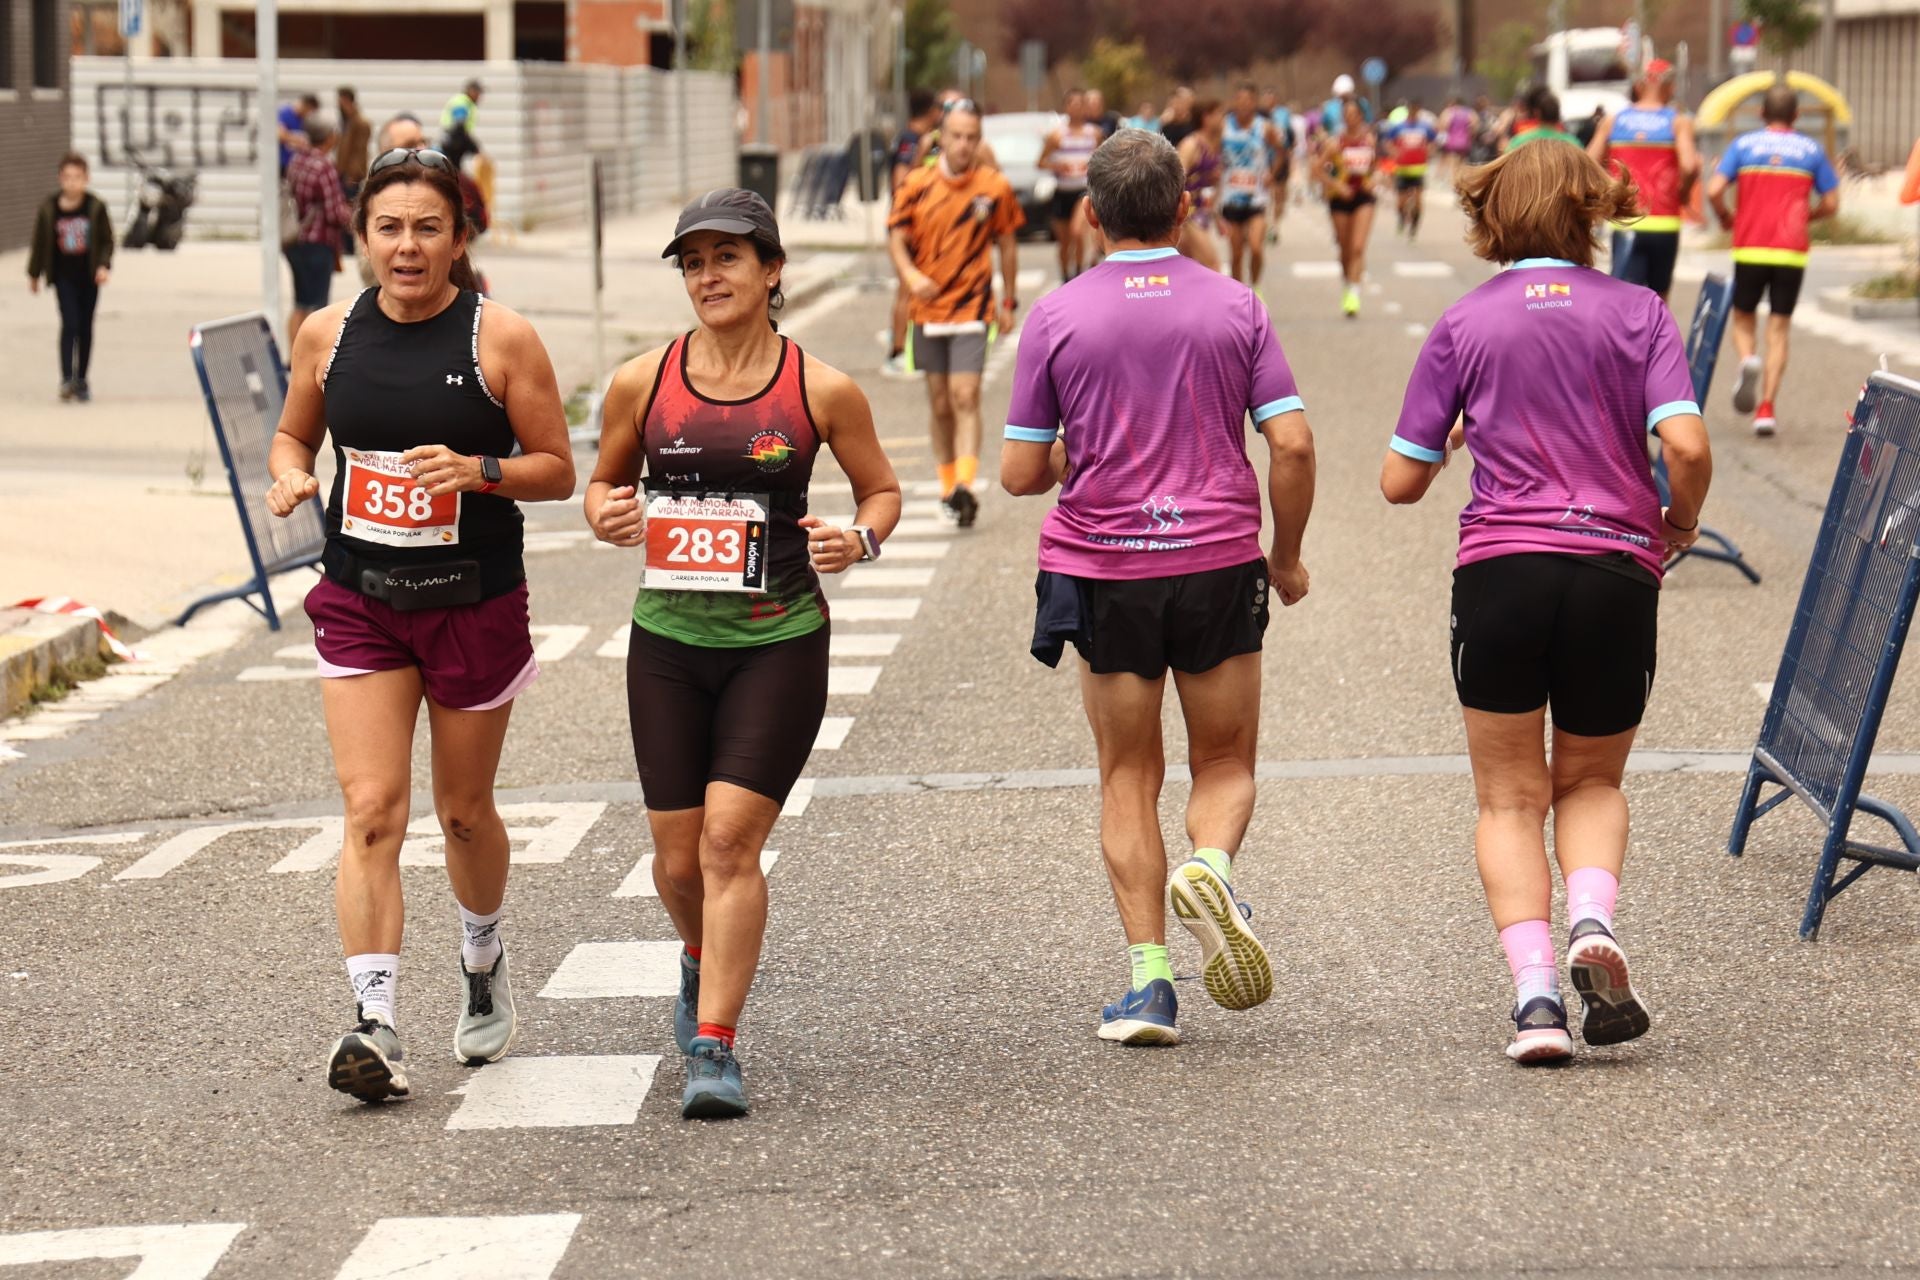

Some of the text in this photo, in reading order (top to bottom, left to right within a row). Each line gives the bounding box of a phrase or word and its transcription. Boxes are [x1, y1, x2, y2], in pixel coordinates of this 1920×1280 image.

[1125, 290, 1172, 299] VALLADOLID
[1526, 300, 1573, 310] VALLADOLID
[472, 305, 482, 334] ARMOUR
[474, 366, 492, 397] ARMOUR
[659, 447, 703, 455] TEAMERGY
[359, 457, 411, 474] VIDAL-MATA
[364, 479, 433, 521] 358
[667, 498, 745, 509] XXIX MEMORIAL
[657, 506, 756, 519] VIDAL-MATARRANZ
[366, 525, 391, 536] CARRERA
[666, 526, 740, 565] 283
[747, 541, 760, 579] MÓNICA
[671, 574, 730, 583] CARRERA POPULAR
